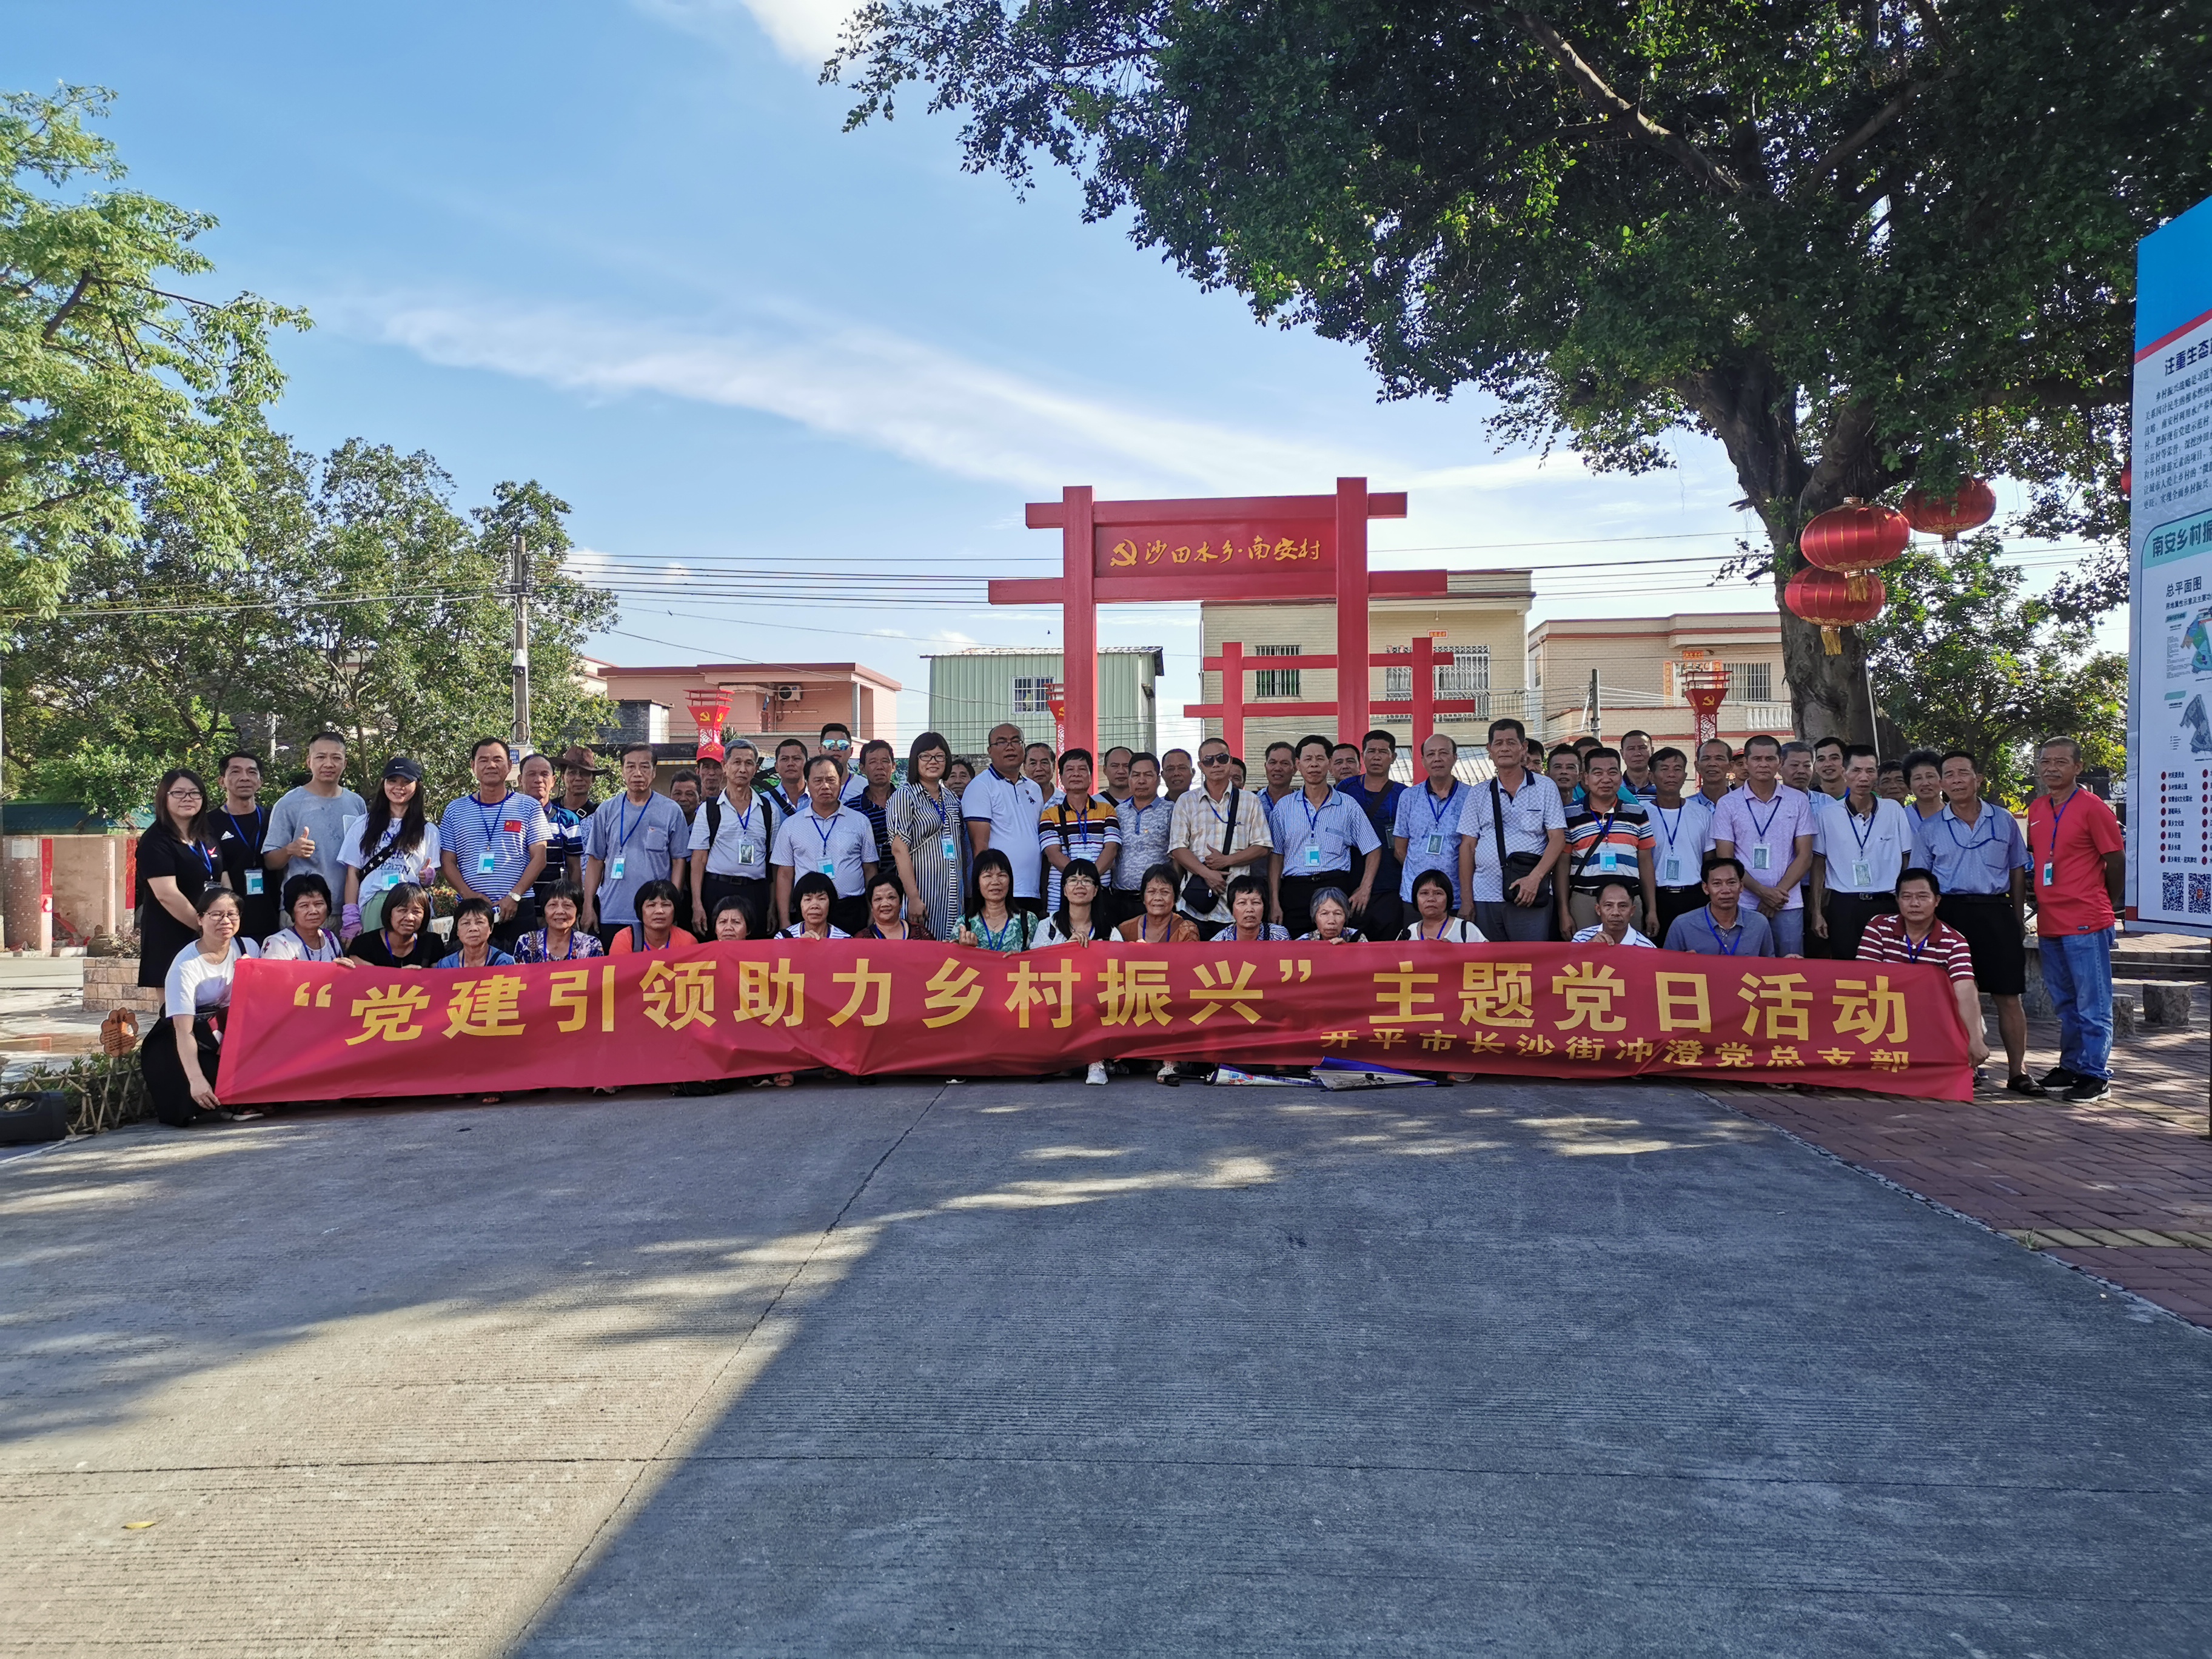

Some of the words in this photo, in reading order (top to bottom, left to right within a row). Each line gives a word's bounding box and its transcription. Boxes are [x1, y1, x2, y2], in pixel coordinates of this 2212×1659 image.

[1145, 535, 1320, 565] 沙田水乡·南安村
[2166, 576, 2202, 597] 总平面图
[293, 958, 1909, 1046] “党建引领助力乡村振兴”主题党日活动
[1320, 1028, 1909, 1073] 开平市长沙街冲澄党总支部
